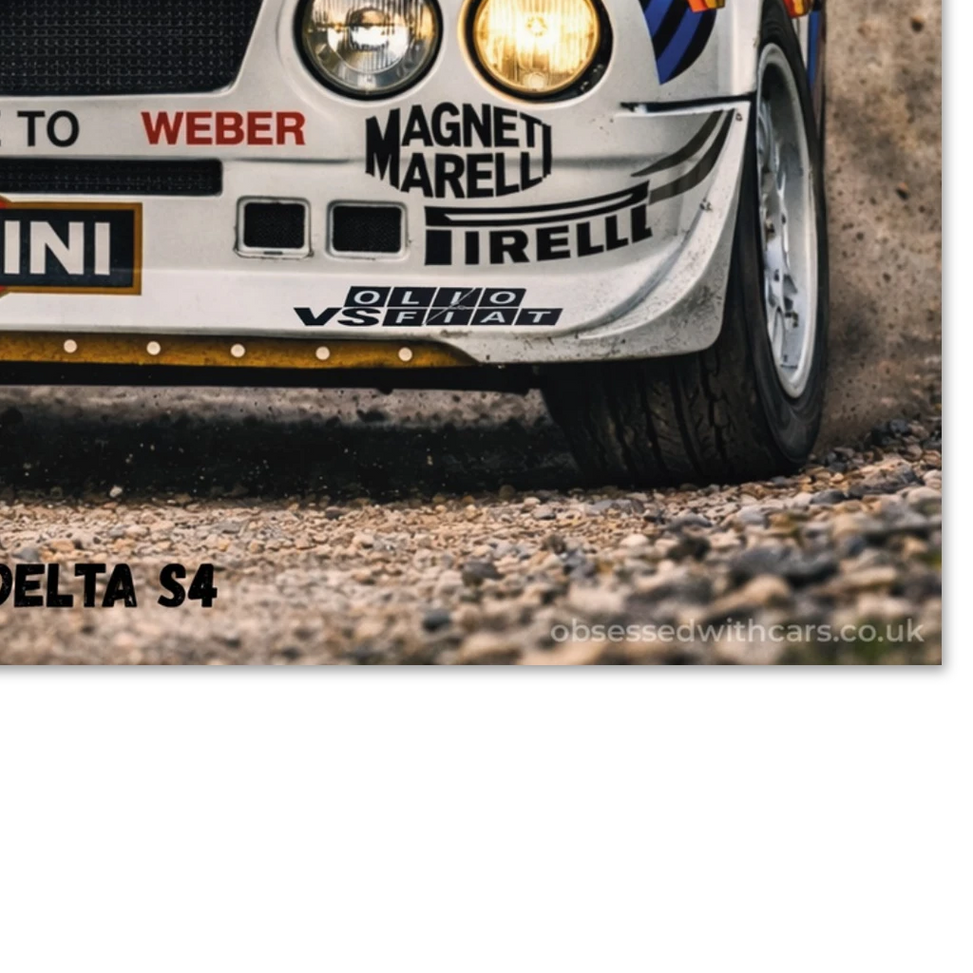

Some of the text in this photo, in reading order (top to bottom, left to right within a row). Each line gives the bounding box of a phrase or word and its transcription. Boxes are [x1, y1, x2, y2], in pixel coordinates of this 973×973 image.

[17, 110, 80, 147] TO
[141, 112, 306, 145] WEBER
[354, 289, 515, 307] OLIO
